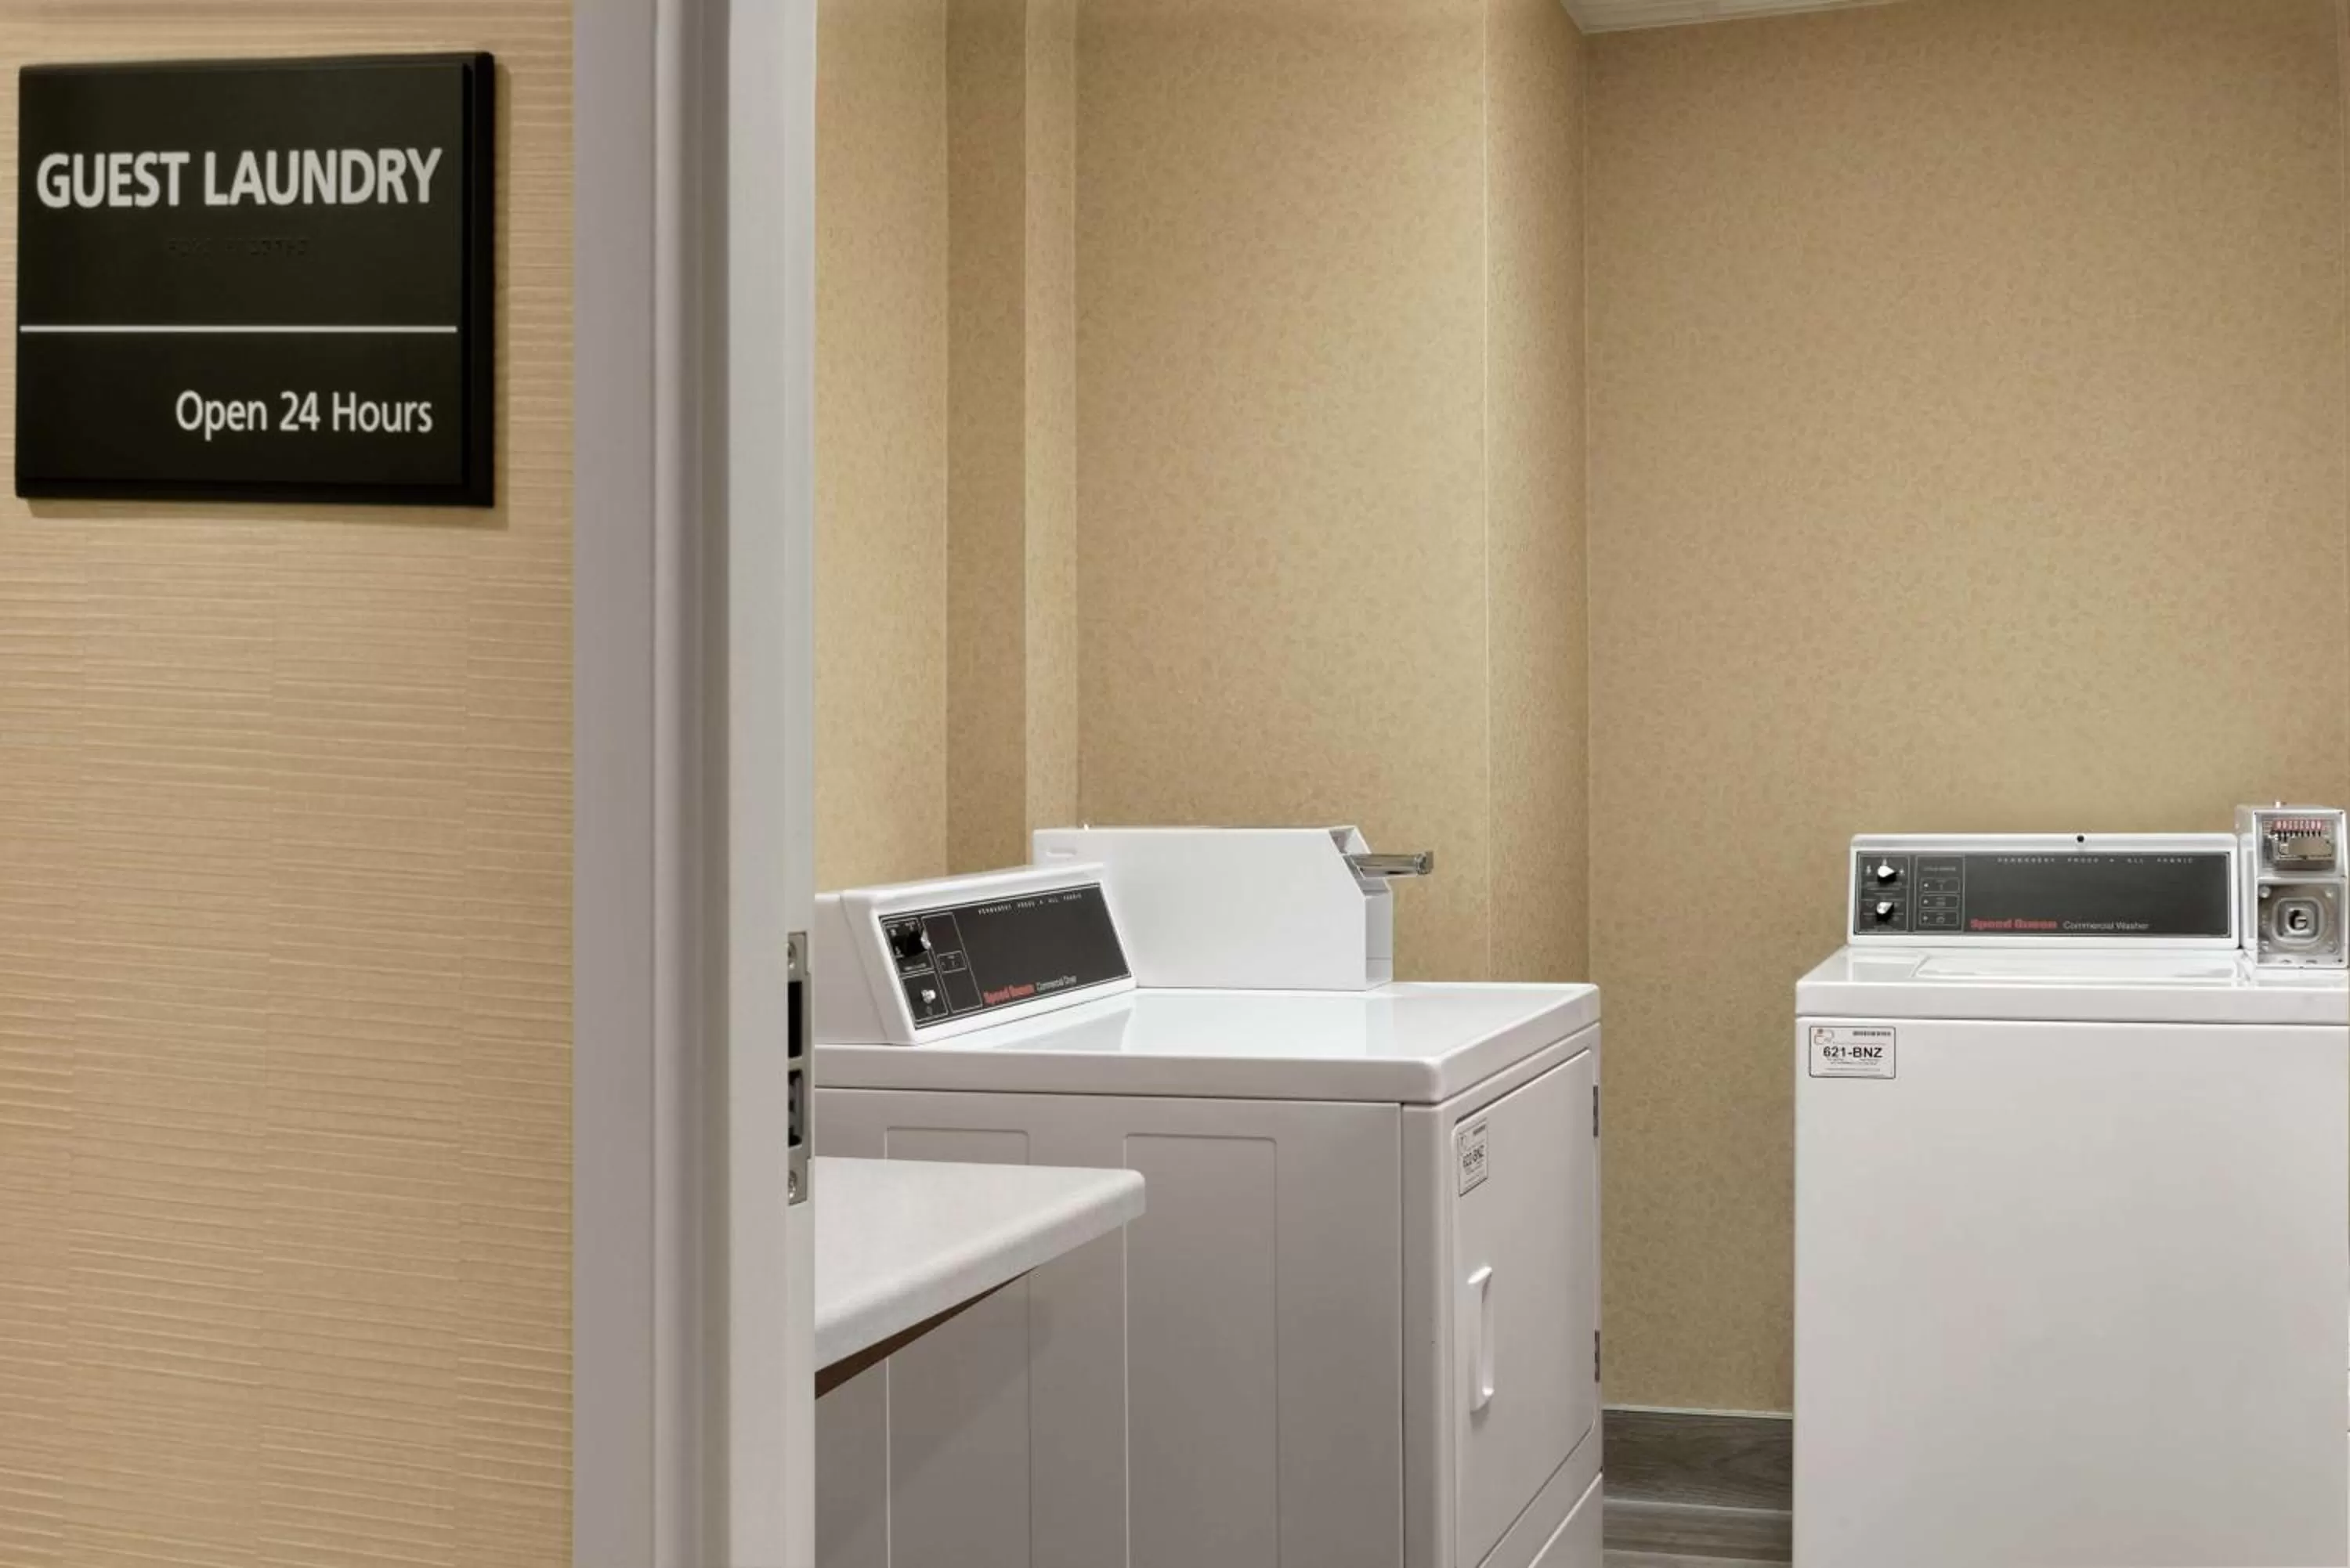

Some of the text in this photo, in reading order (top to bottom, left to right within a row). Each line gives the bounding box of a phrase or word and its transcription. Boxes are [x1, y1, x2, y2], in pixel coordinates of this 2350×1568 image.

[36, 147, 443, 208] GUEST LAUNDRY
[175, 389, 433, 442] Open 24 Hours
[2062, 919, 2114, 930] Commercial
[2116, 920, 2149, 930] Washer
[1823, 1046, 1883, 1058] 621-BNZ
